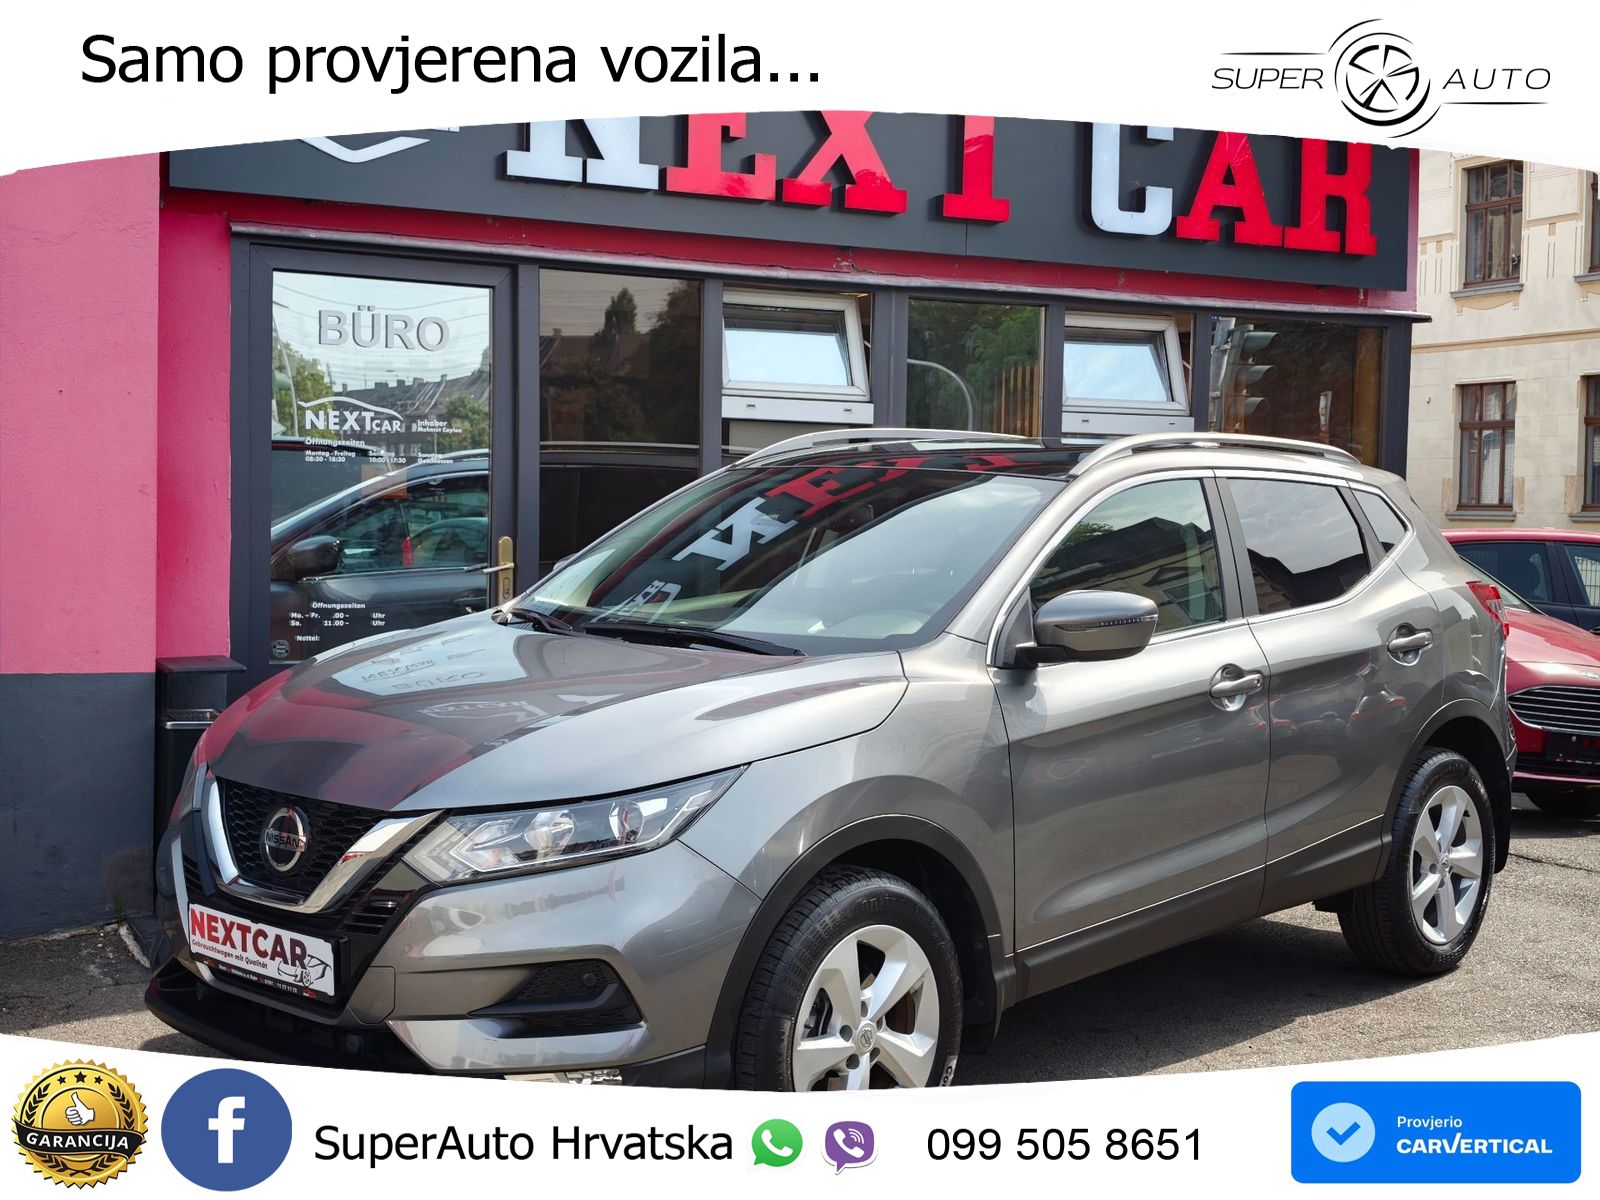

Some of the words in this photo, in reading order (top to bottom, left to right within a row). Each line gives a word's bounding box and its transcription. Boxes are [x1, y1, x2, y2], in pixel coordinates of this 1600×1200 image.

[1091, 121, 1377, 256] CAR
[318, 305, 450, 352] BÜRO
[417, 419, 448, 427] Inhaber
[305, 438, 365, 447] Öffnungszeiten
[305, 450, 329, 458] Montag
[334, 450, 356, 458] Freitag
[312, 601, 366, 610] Öffnungszeiten
[265, 831, 302, 849] NISSAN
[190, 908, 308, 970] NEXTCAR
[192, 938, 235, 960] Gebrauchtwagen
[234, 953, 244, 962] mit
[244, 957, 268, 970] Qualität
